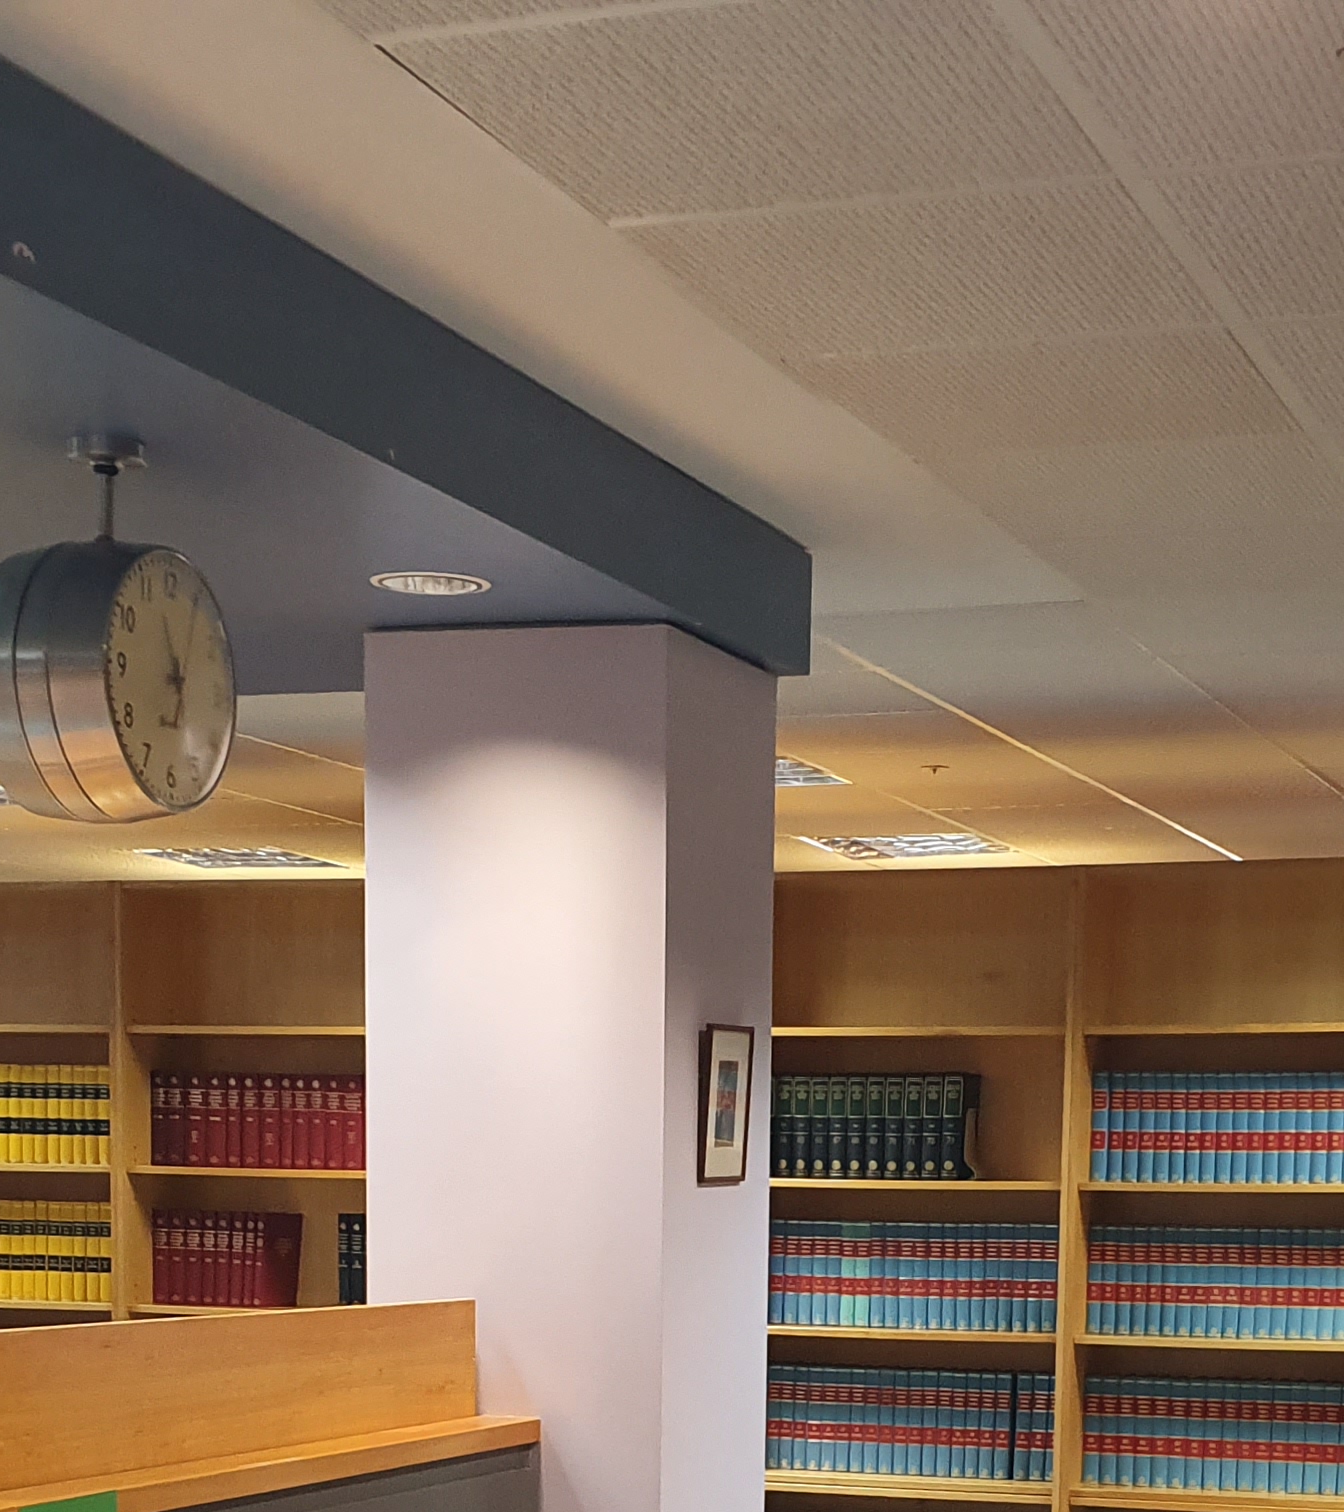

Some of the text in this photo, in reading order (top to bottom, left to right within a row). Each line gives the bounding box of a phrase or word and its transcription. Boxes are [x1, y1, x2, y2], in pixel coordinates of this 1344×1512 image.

[140, 573, 152, 602] 11
[164, 570, 176, 600] 12
[119, 603, 136, 634] 10
[117, 651, 127, 678] 9
[123, 702, 134, 729] 8
[142, 742, 152, 768] 7
[166, 764, 177, 788] 6
